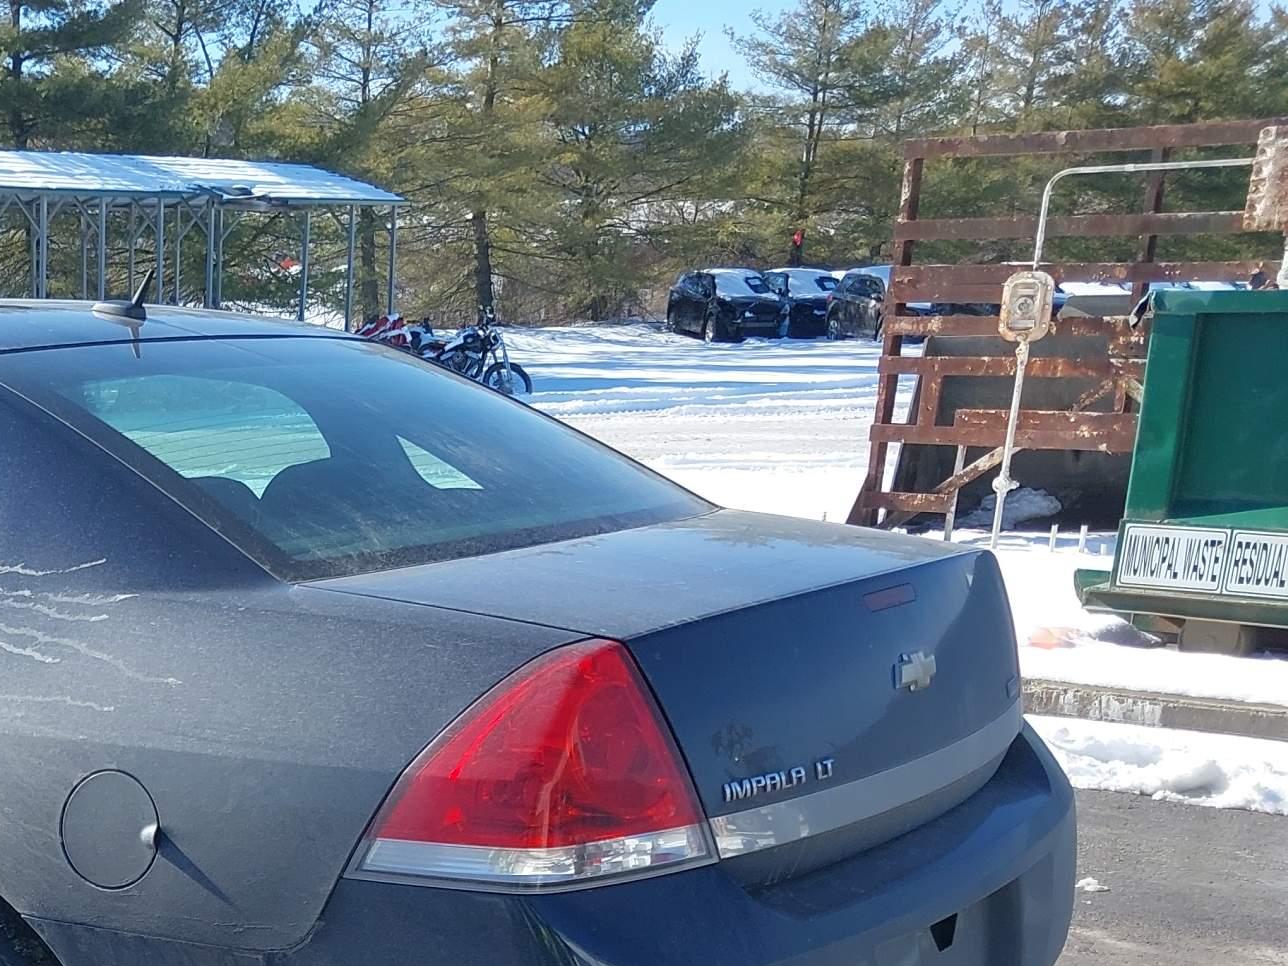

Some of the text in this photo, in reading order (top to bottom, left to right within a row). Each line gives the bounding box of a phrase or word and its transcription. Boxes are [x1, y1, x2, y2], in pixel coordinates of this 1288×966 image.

[1124, 534, 1223, 582] MUNICIPAL WASTE
[1230, 540, 1288, 588] RESIDUAL
[723, 759, 834, 802] IMPALA LT
